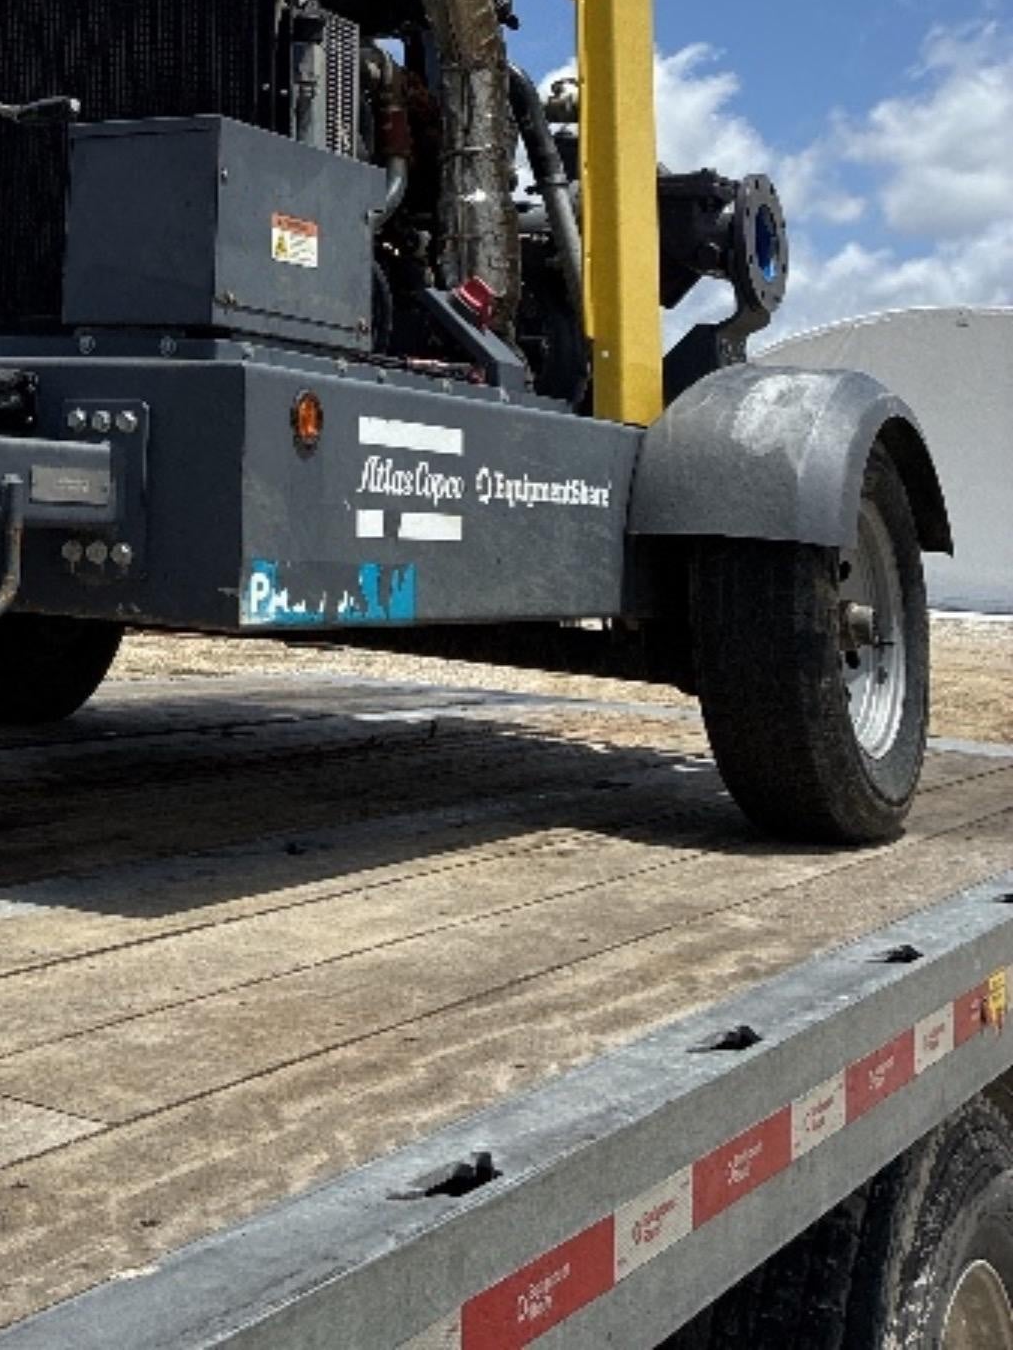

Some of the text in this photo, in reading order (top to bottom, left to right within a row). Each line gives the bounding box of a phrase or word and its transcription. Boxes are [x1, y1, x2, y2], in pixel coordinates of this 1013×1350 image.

[356, 454, 465, 507] Atlas Copco
[493, 468, 610, 509] EquipmentShare
